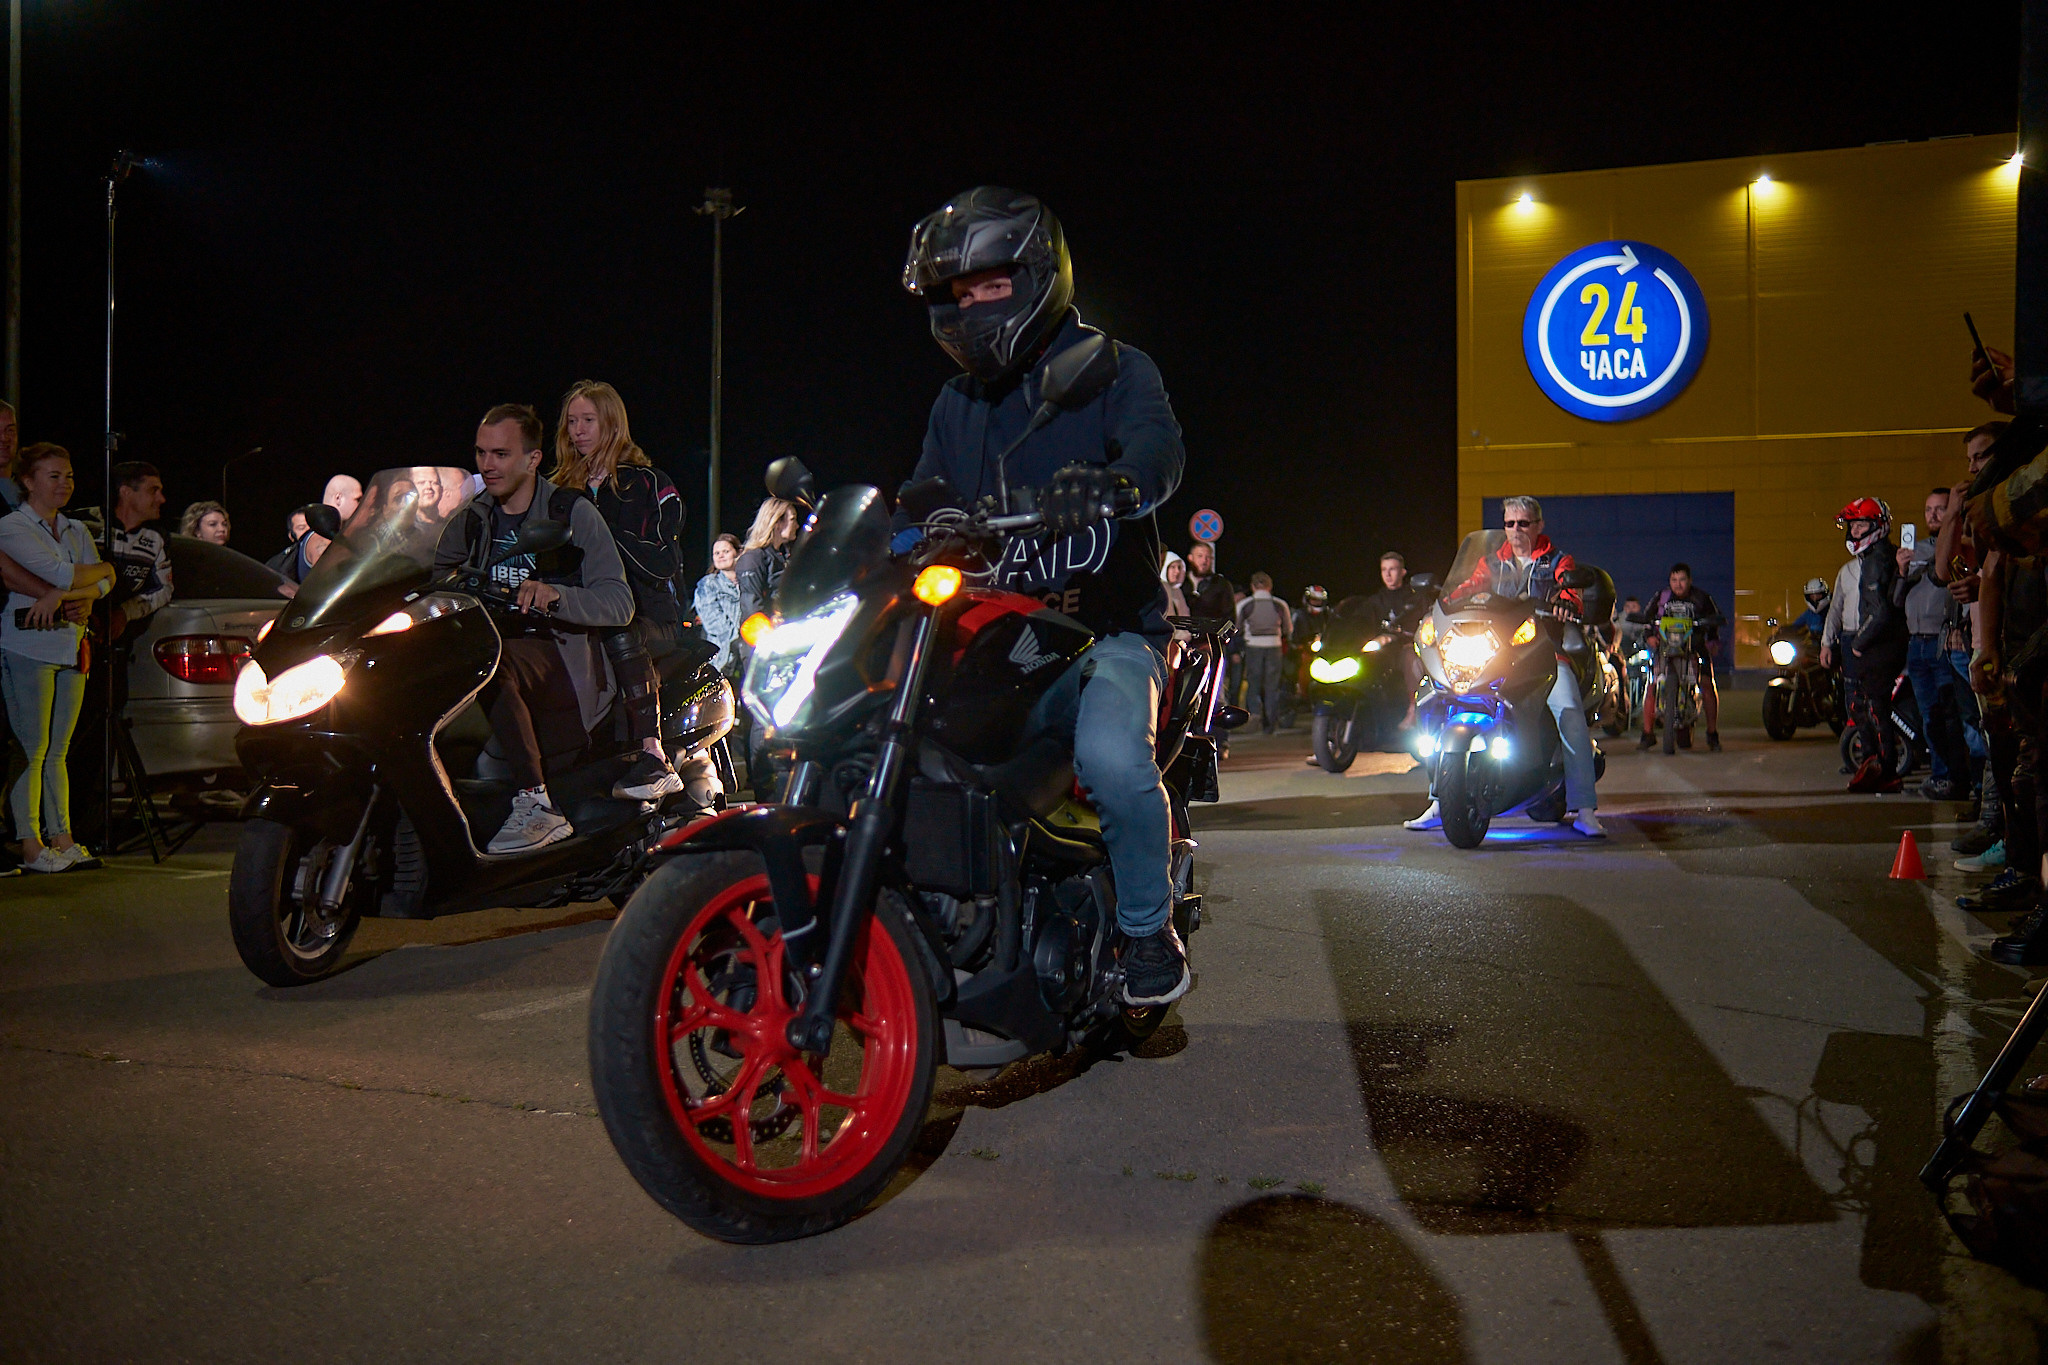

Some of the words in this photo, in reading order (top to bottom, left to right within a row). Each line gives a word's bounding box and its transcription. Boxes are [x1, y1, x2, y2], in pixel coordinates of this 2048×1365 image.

[1580, 281, 1648, 346] 24
[1580, 347, 1647, 381] ЧАСА
[492, 565, 530, 582] IBES
[1019, 652, 1062, 675] HONDA
[1890, 710, 1916, 740] YAMAHA
